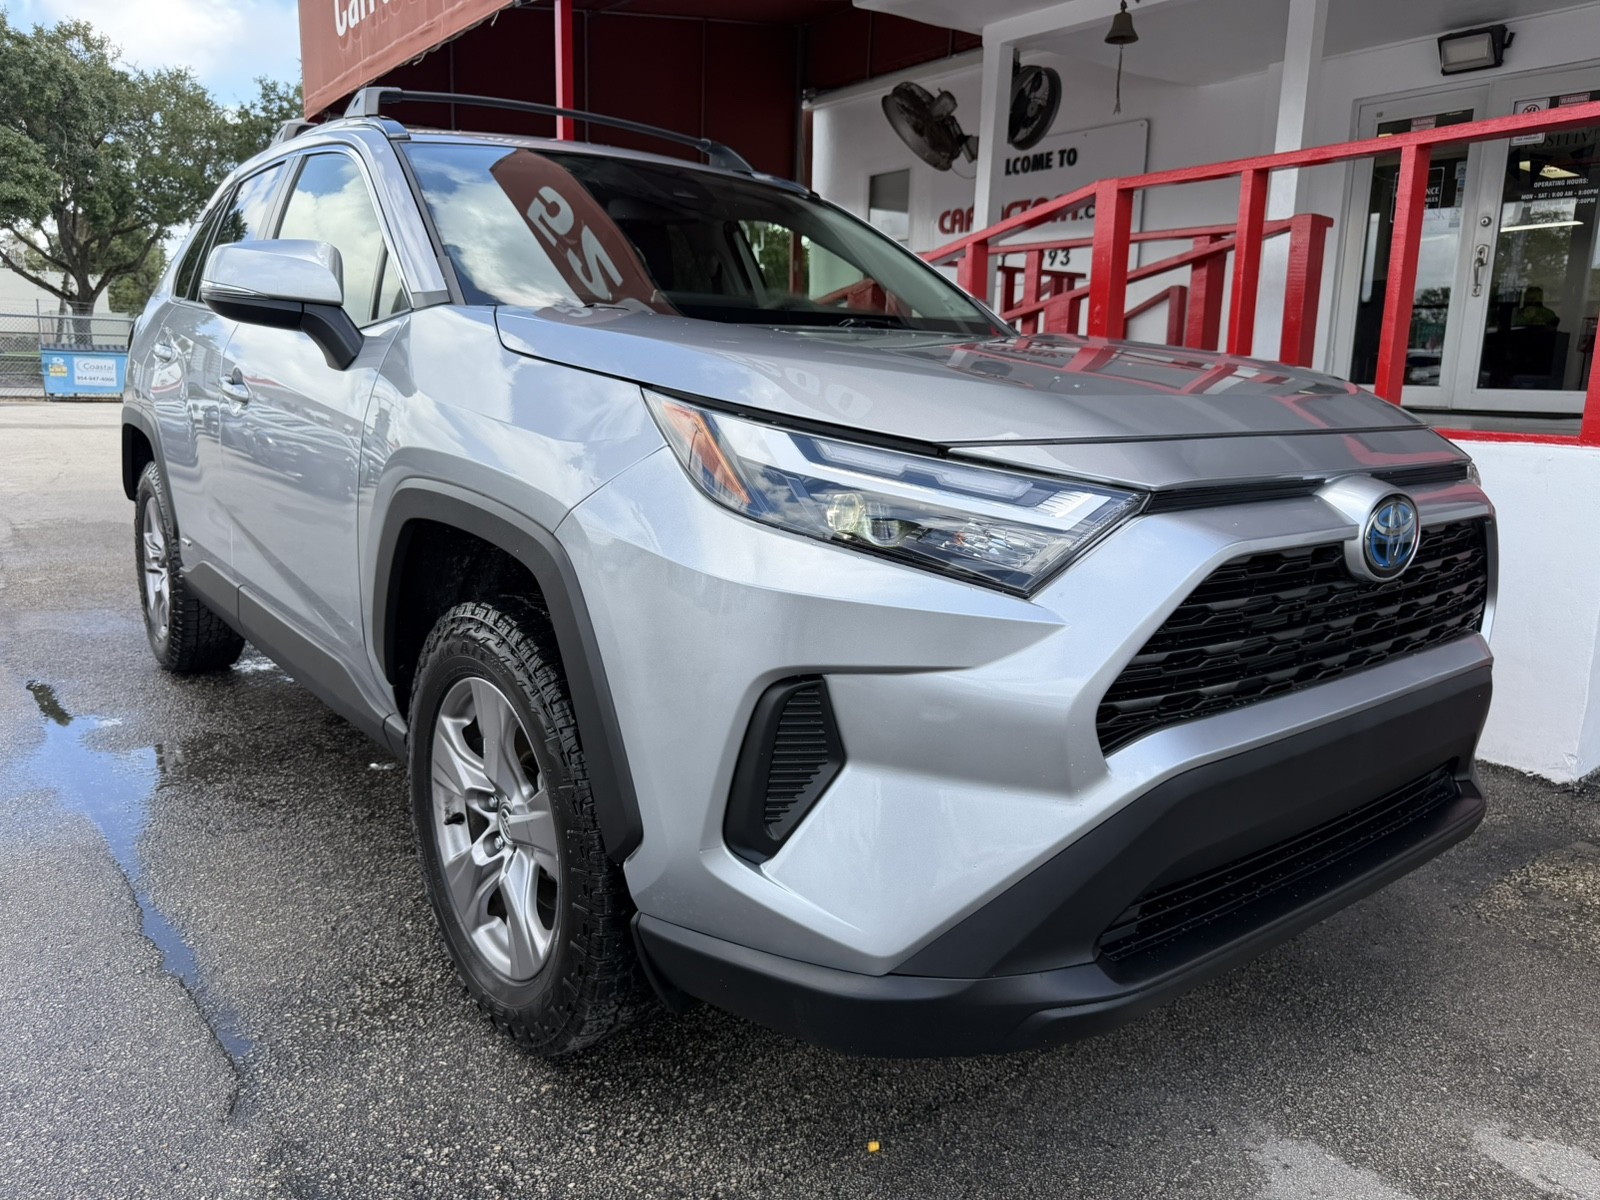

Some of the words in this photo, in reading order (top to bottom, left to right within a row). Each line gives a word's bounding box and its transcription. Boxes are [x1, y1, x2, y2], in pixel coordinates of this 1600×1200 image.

[1005, 151, 1054, 176] LCOME
[1058, 147, 1078, 168] TO
[1533, 180, 1565, 188] OPERATING
[1048, 250, 1071, 267] 93
[83, 362, 114, 371] Coastal
